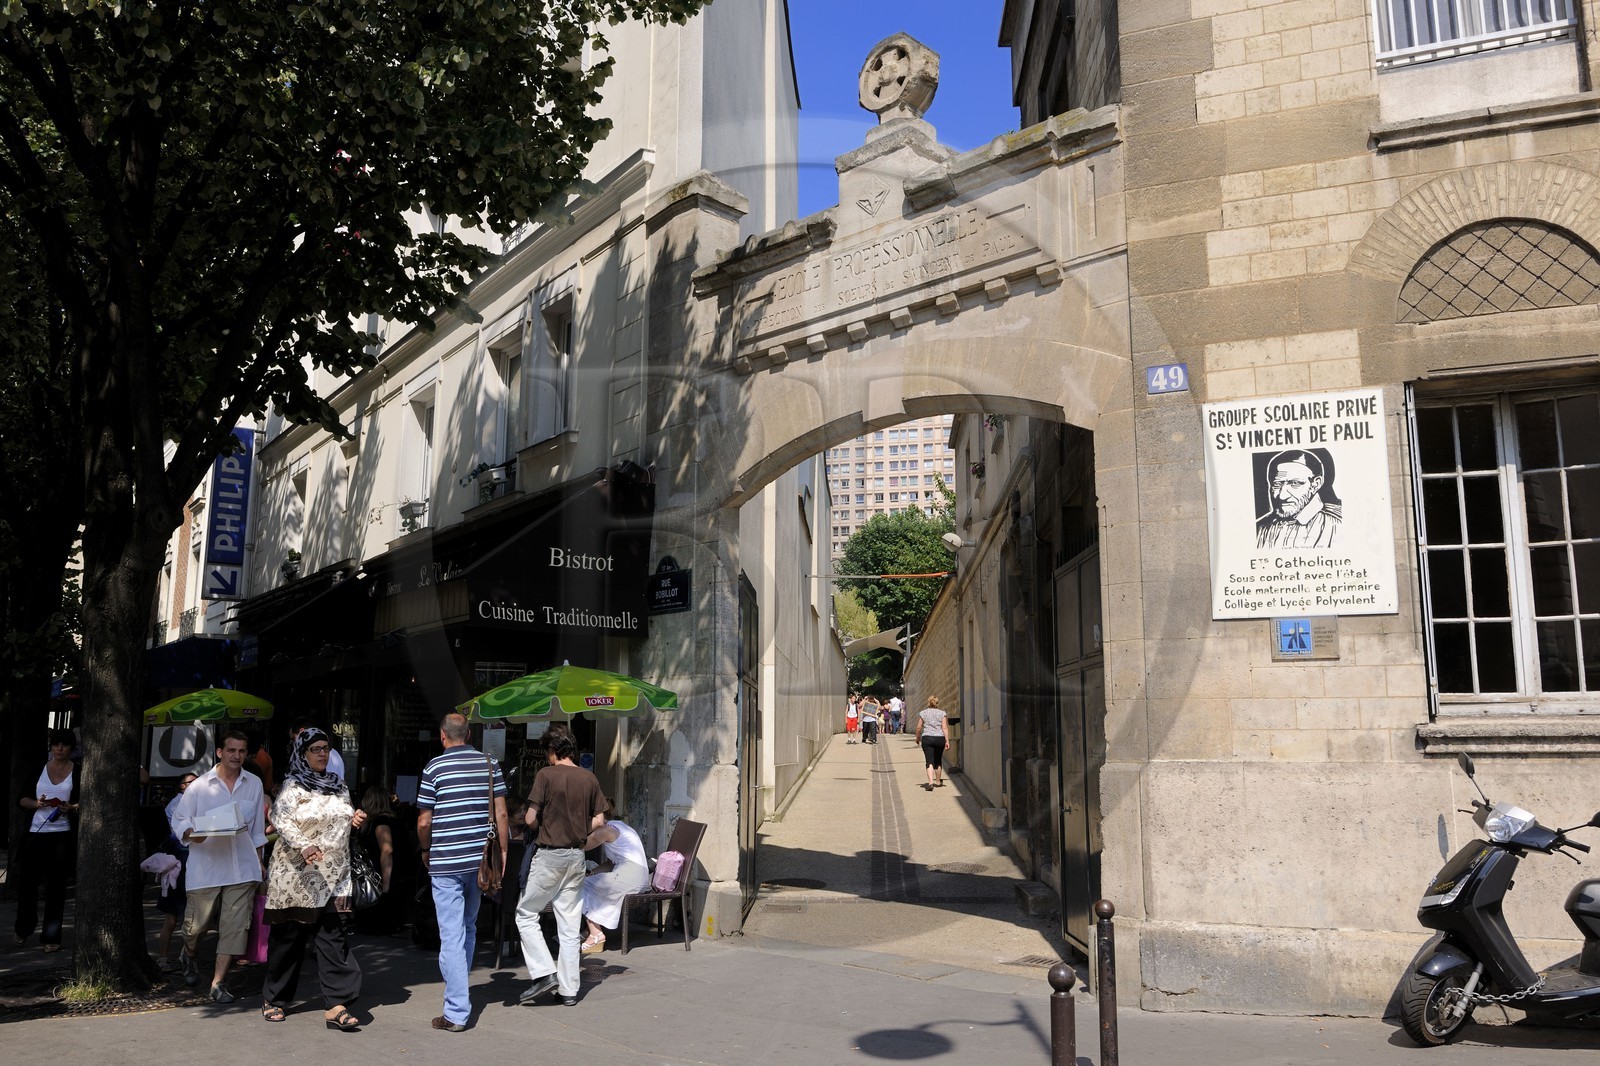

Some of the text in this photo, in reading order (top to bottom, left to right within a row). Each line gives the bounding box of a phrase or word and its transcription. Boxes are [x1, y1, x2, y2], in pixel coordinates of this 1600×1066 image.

[981, 234, 1016, 258] PAUL
[1151, 366, 1184, 390] 49
[1208, 395, 1377, 429] GROUPE SCOLAIRE PRIVÉ
[1237, 426, 1303, 448] VINCENT
[1309, 424, 1328, 443] DE
[1333, 421, 1374, 442] PAUL
[548, 546, 614, 572] Bistrot
[1275, 556, 1352, 569] Catholique
[661, 578, 671, 587] RUE
[1229, 569, 1368, 583] Sous contrat avec l'état
[1224, 581, 1381, 596] Ecole maternelle et primaire
[1224, 594, 1376, 611] Collège et Lycée Polyvalent
[478, 599, 639, 630] Cuisine Traditionnelle
[588, 698, 613, 706] JOKER
